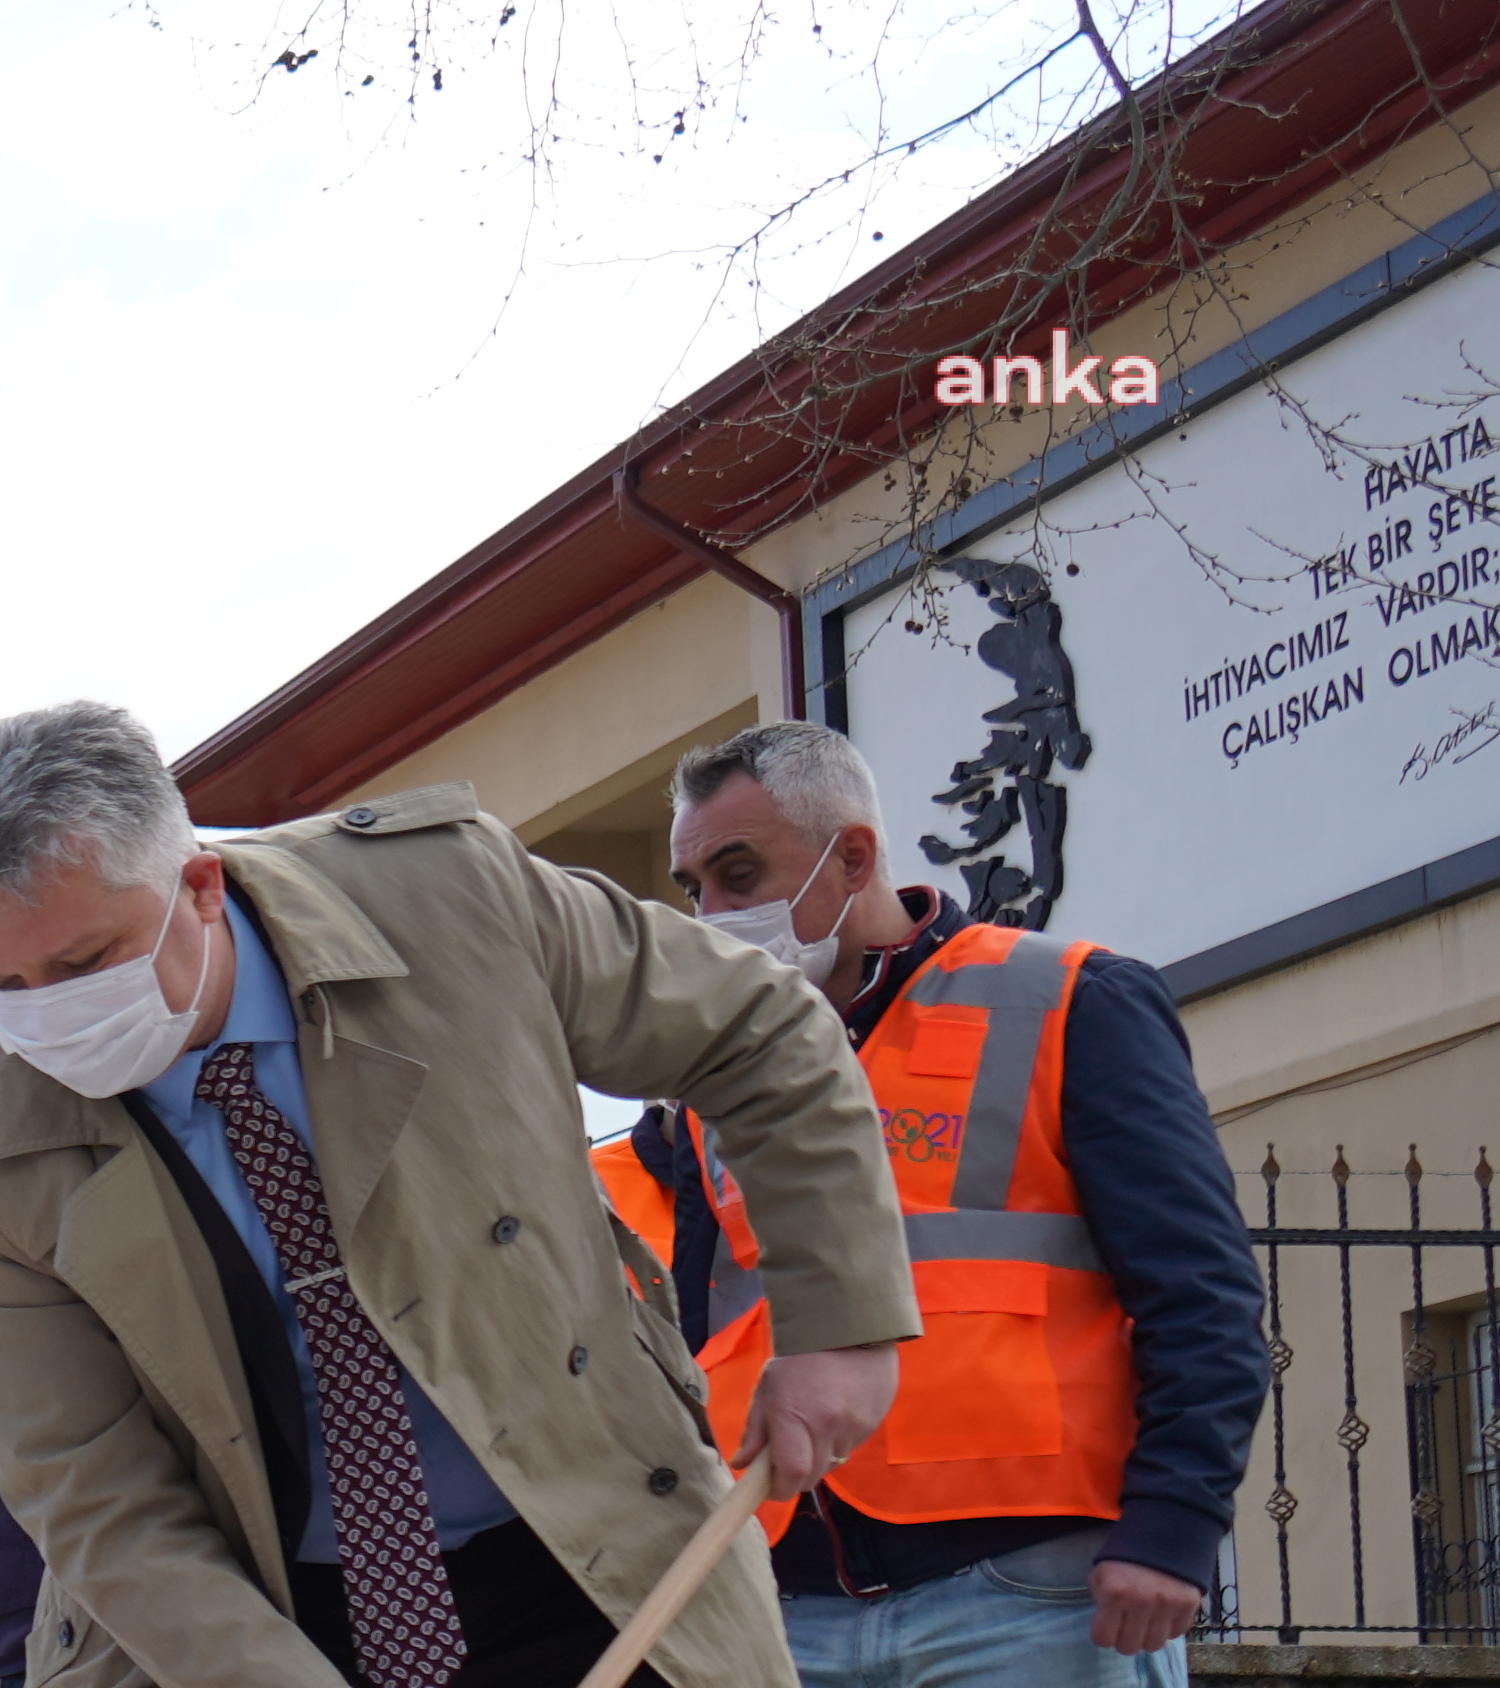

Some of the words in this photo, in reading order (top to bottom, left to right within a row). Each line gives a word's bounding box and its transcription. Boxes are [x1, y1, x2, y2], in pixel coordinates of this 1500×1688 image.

[1308, 543, 1358, 600] TEK
[1367, 515, 1413, 572] BİR
[1428, 474, 1497, 554] ŞEYE
[1364, 417, 1493, 512] HAYATTA
[1184, 610, 1350, 722] İHTİYACIMIZ
[1375, 547, 1499, 628] VARDIR;
[1222, 666, 1364, 770] ÇALIŞKAN
[1388, 604, 1500, 687] OLMAK
